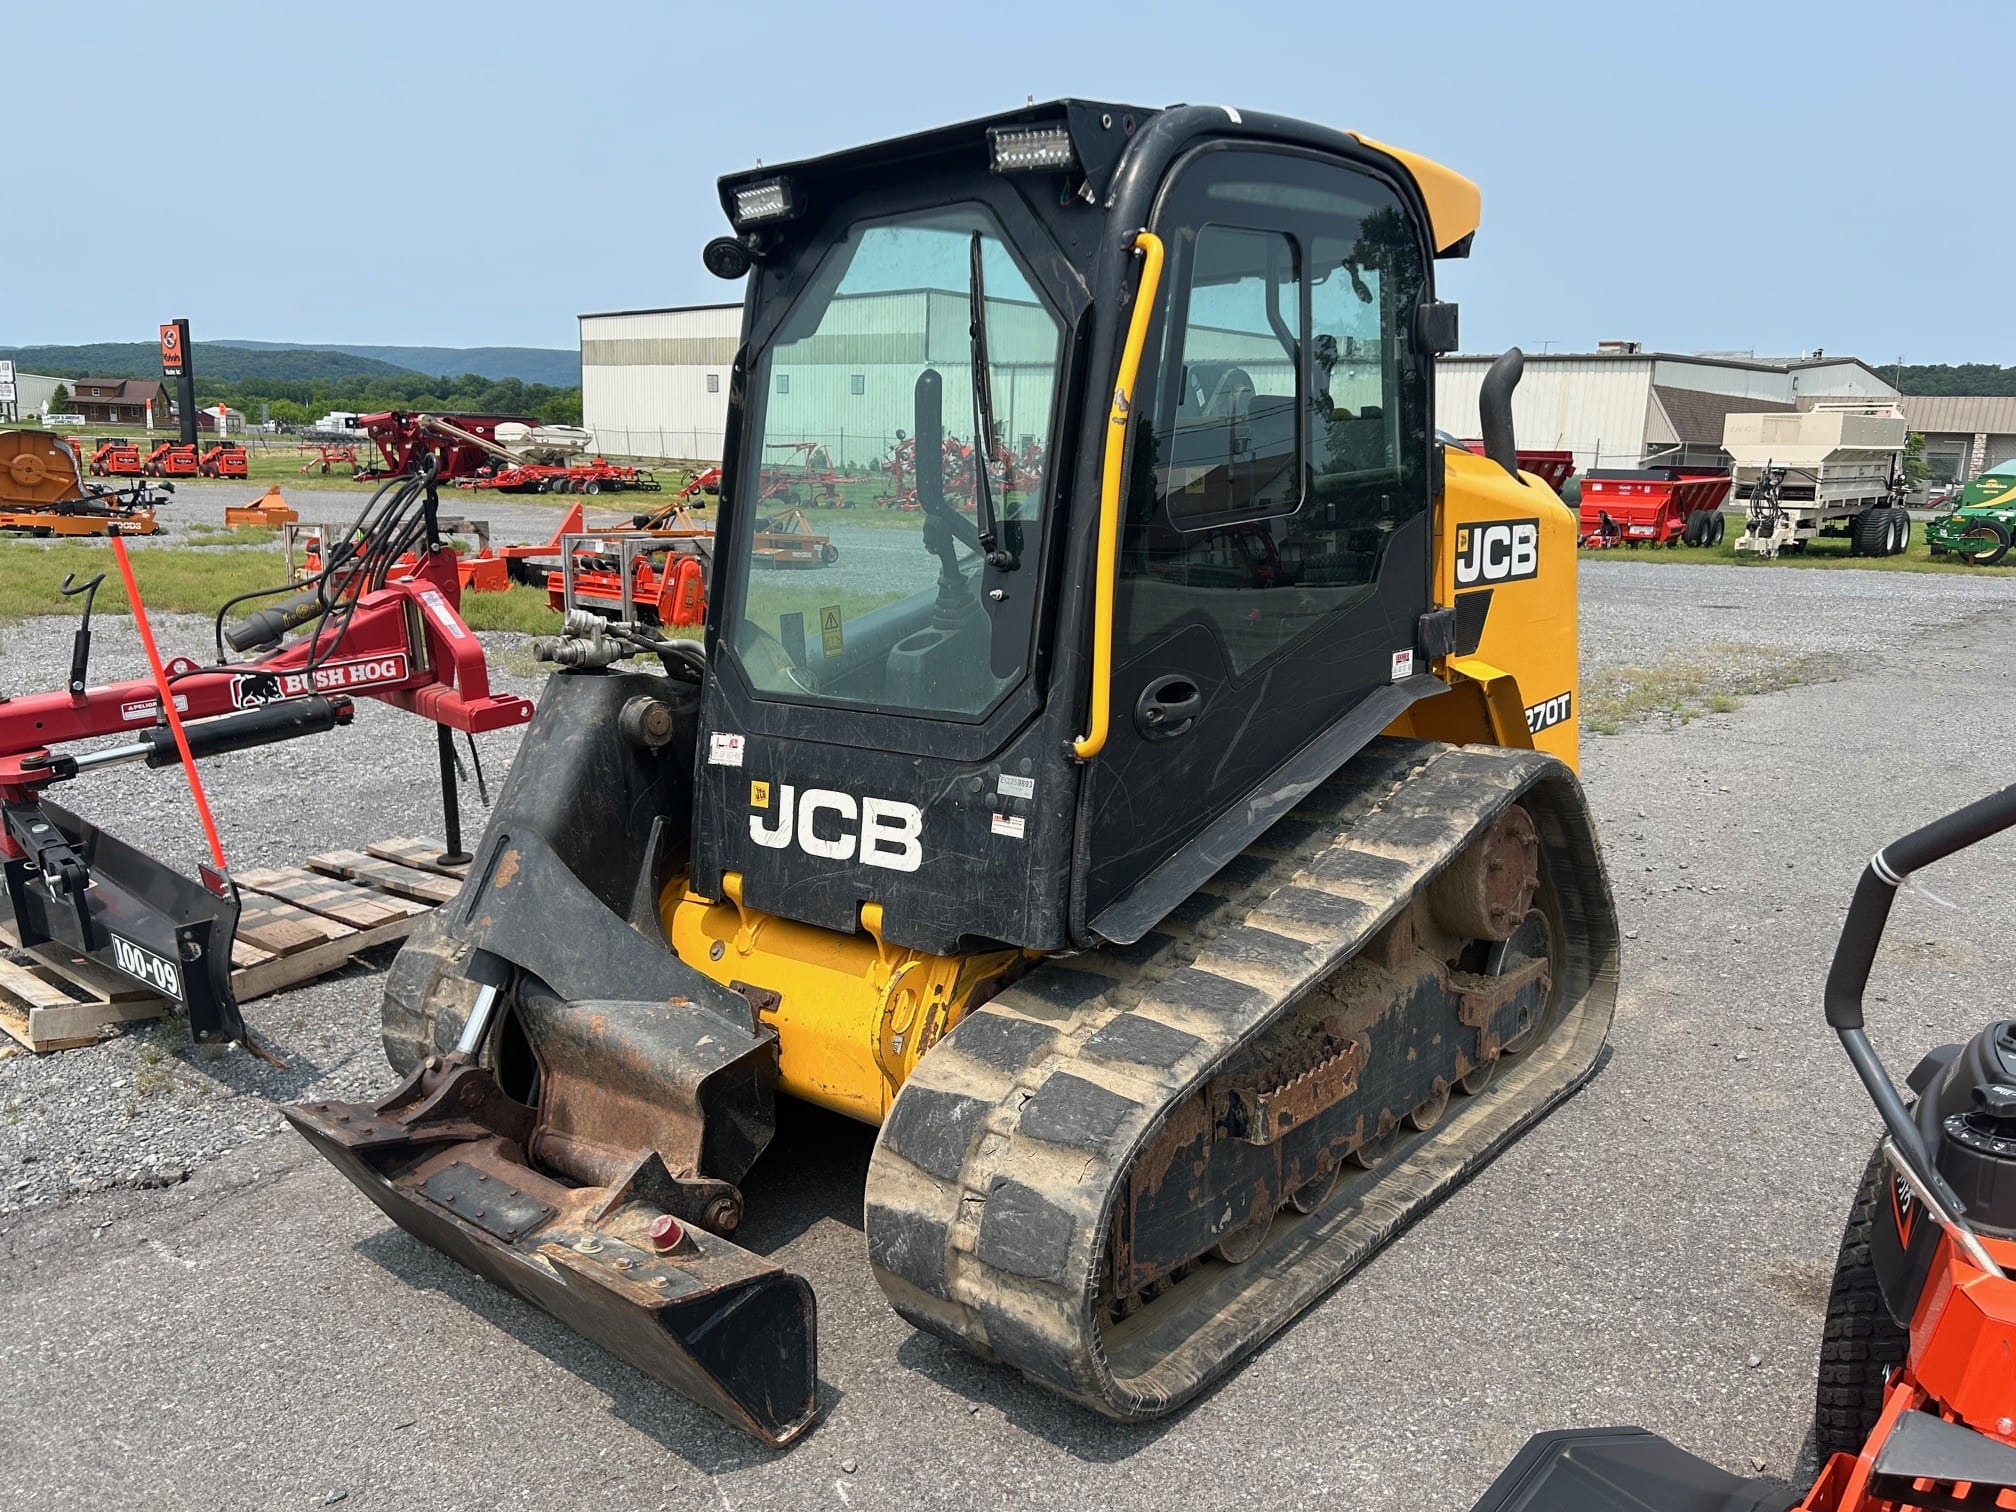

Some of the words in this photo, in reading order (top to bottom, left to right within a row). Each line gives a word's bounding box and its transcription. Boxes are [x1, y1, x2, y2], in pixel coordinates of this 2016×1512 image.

[1456, 524, 1538, 583] JCB
[349, 660, 397, 683] HOG
[1524, 693, 1570, 733] 270T
[749, 784, 923, 873] JCB
[114, 937, 178, 994] 100-09
